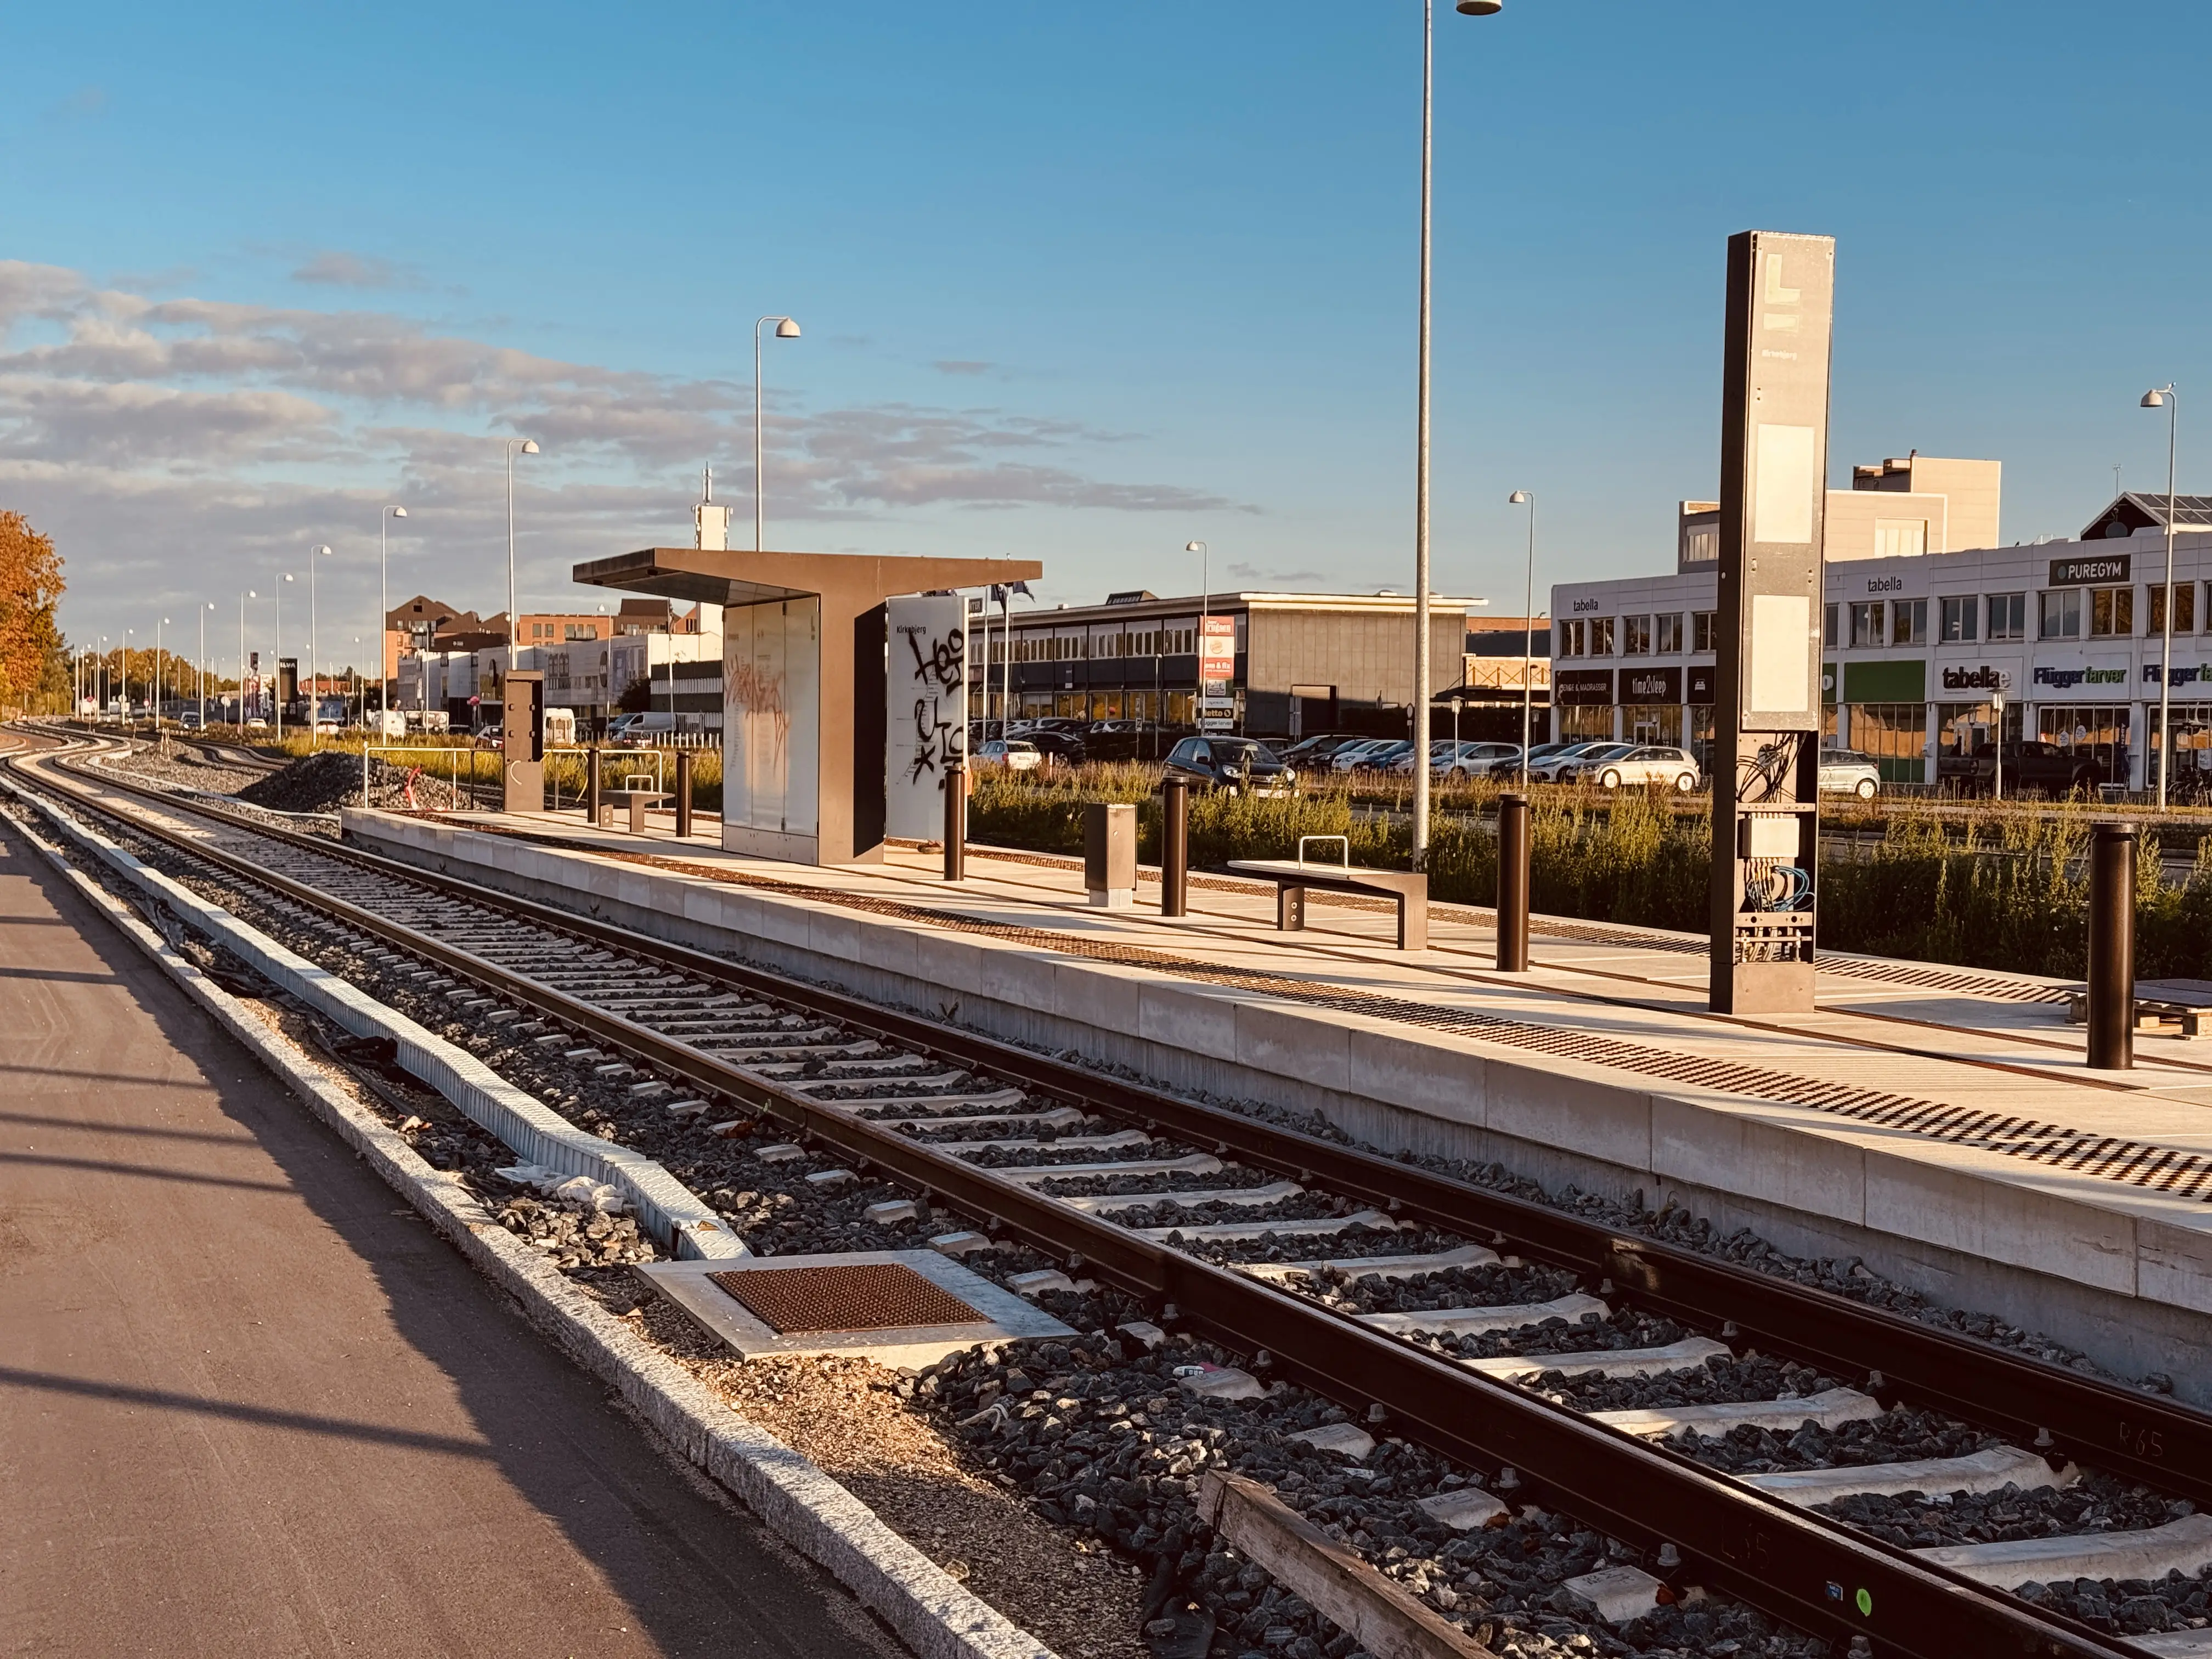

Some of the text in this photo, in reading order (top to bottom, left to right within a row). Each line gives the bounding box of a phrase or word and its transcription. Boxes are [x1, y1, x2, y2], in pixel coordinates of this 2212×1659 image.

[2068, 561, 2122, 579] PUREGYM
[1867, 575, 1902, 592] tabella
[1573, 598, 1599, 612] tabella
[2085, 665, 2127, 684] farver
[1580, 683, 1607, 692] MADRASSER
[1632, 674, 1667, 697] time2sleep
